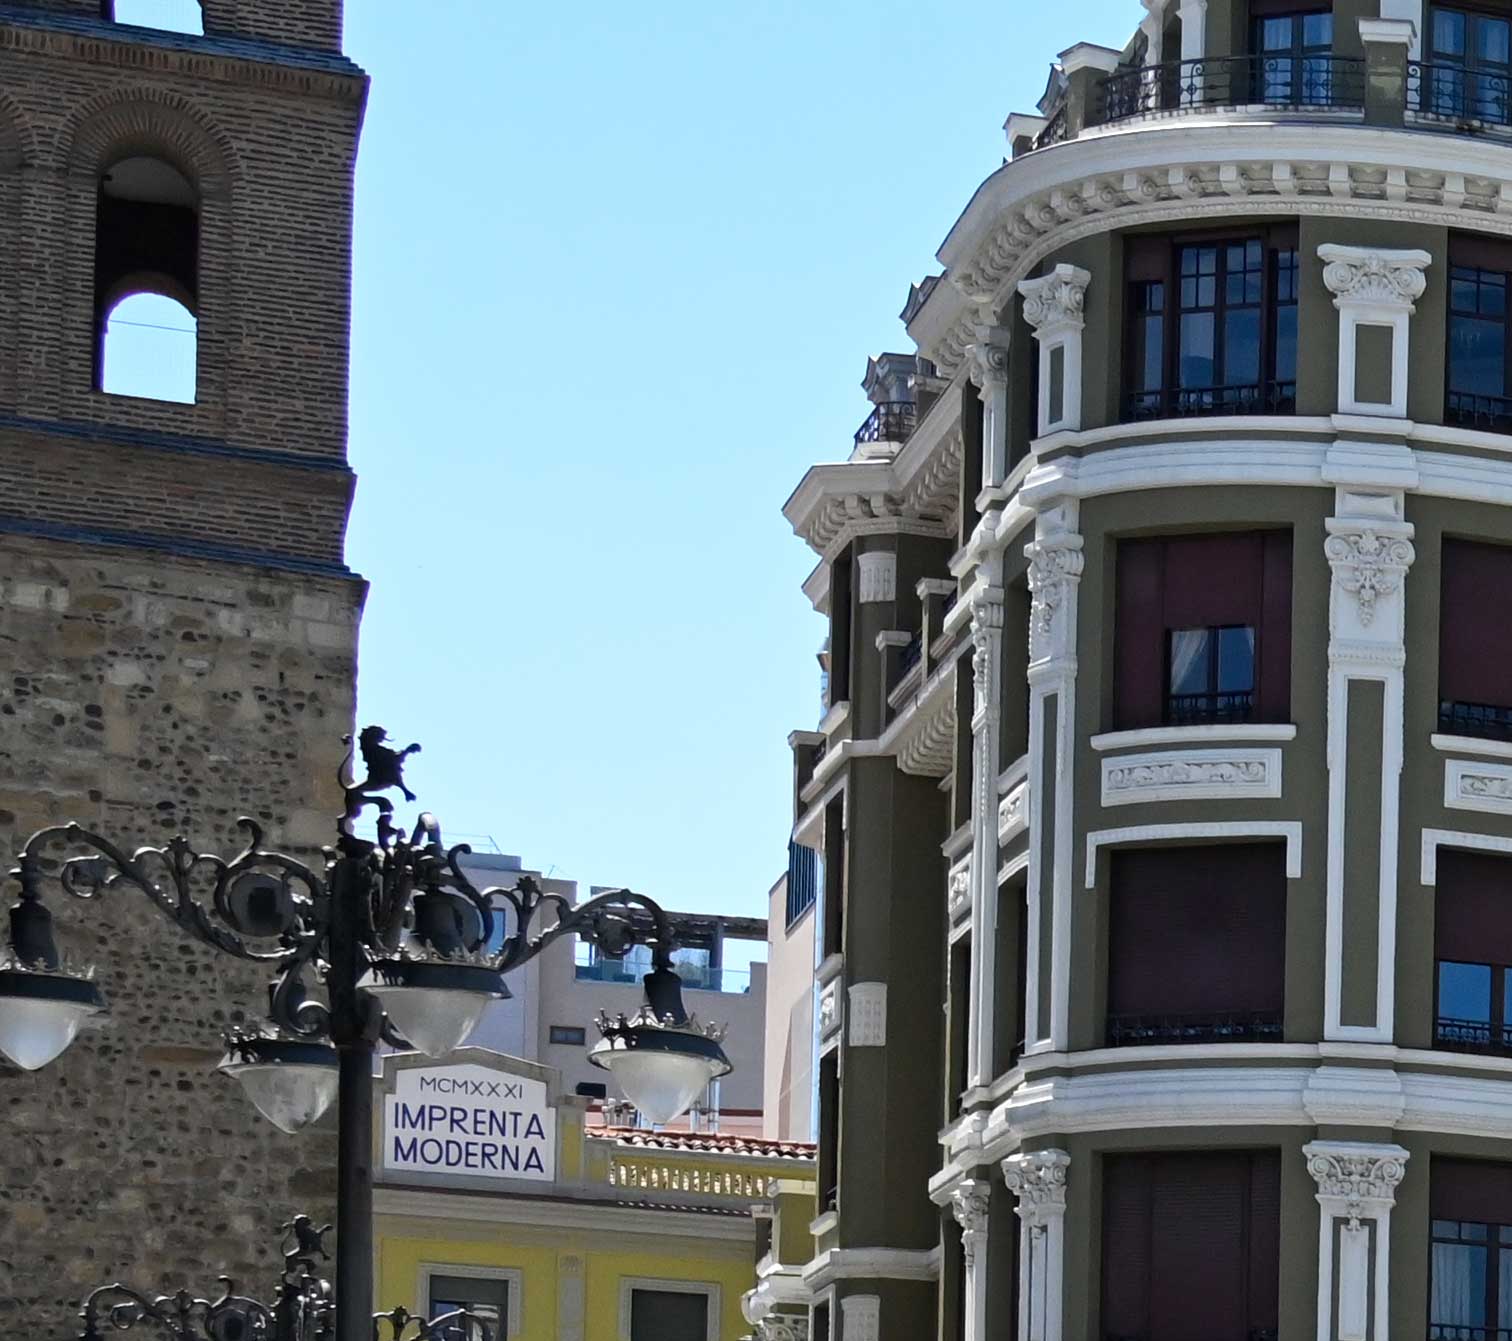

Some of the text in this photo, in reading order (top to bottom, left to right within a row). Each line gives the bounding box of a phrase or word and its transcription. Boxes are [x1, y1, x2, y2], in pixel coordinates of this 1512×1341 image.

[420, 1076, 523, 1099] MCMXXXI
[394, 1102, 546, 1140] IMPRENTA
[394, 1135, 545, 1173] MODERNA
